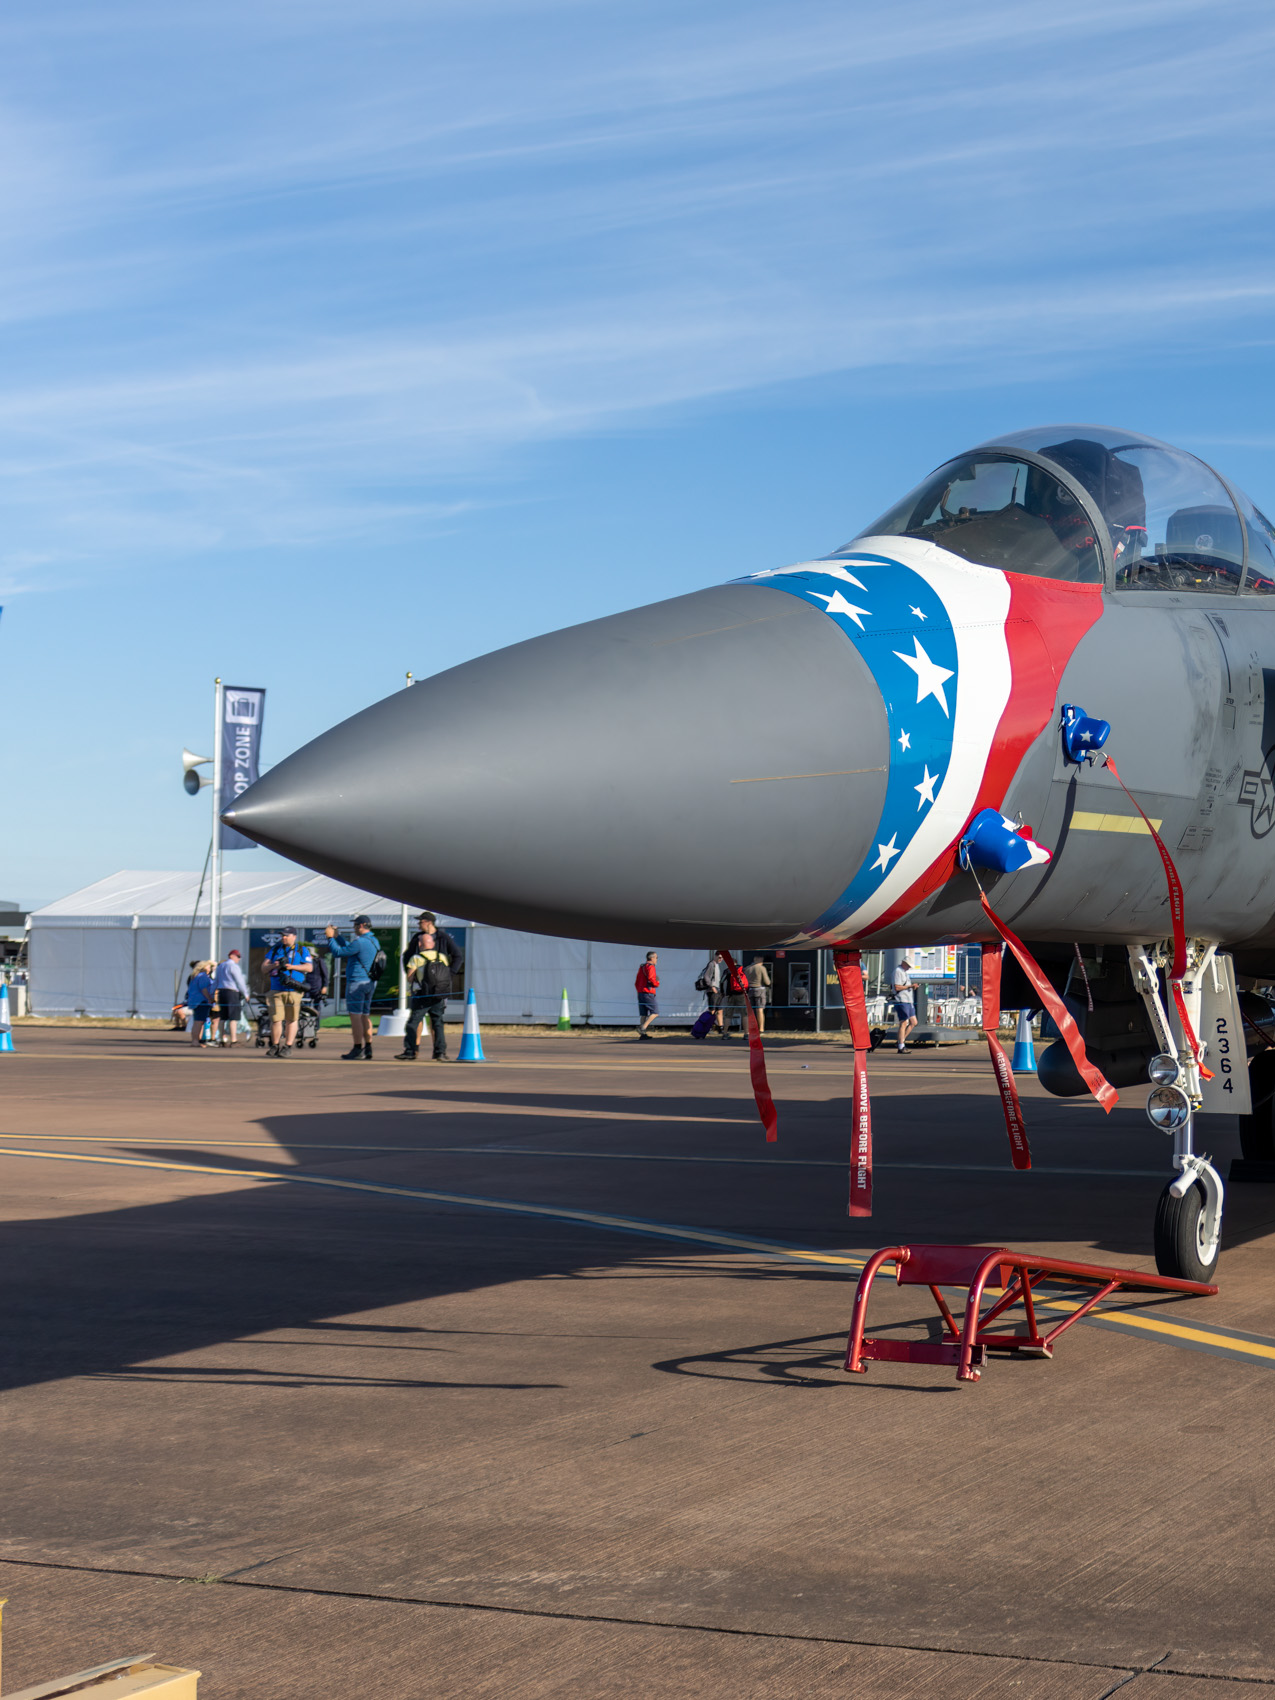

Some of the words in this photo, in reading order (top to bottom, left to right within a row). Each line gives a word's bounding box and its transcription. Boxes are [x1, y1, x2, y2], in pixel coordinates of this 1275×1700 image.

[234, 727, 250, 768] ZONE
[996, 1051, 1010, 1088] REMOVE
[1003, 1090, 1017, 1122] BEFORE
[1011, 1123, 1024, 1151] FLIGHT
[858, 1115, 868, 1154] BEFORE
[857, 1155, 867, 1190] FLIGHT
